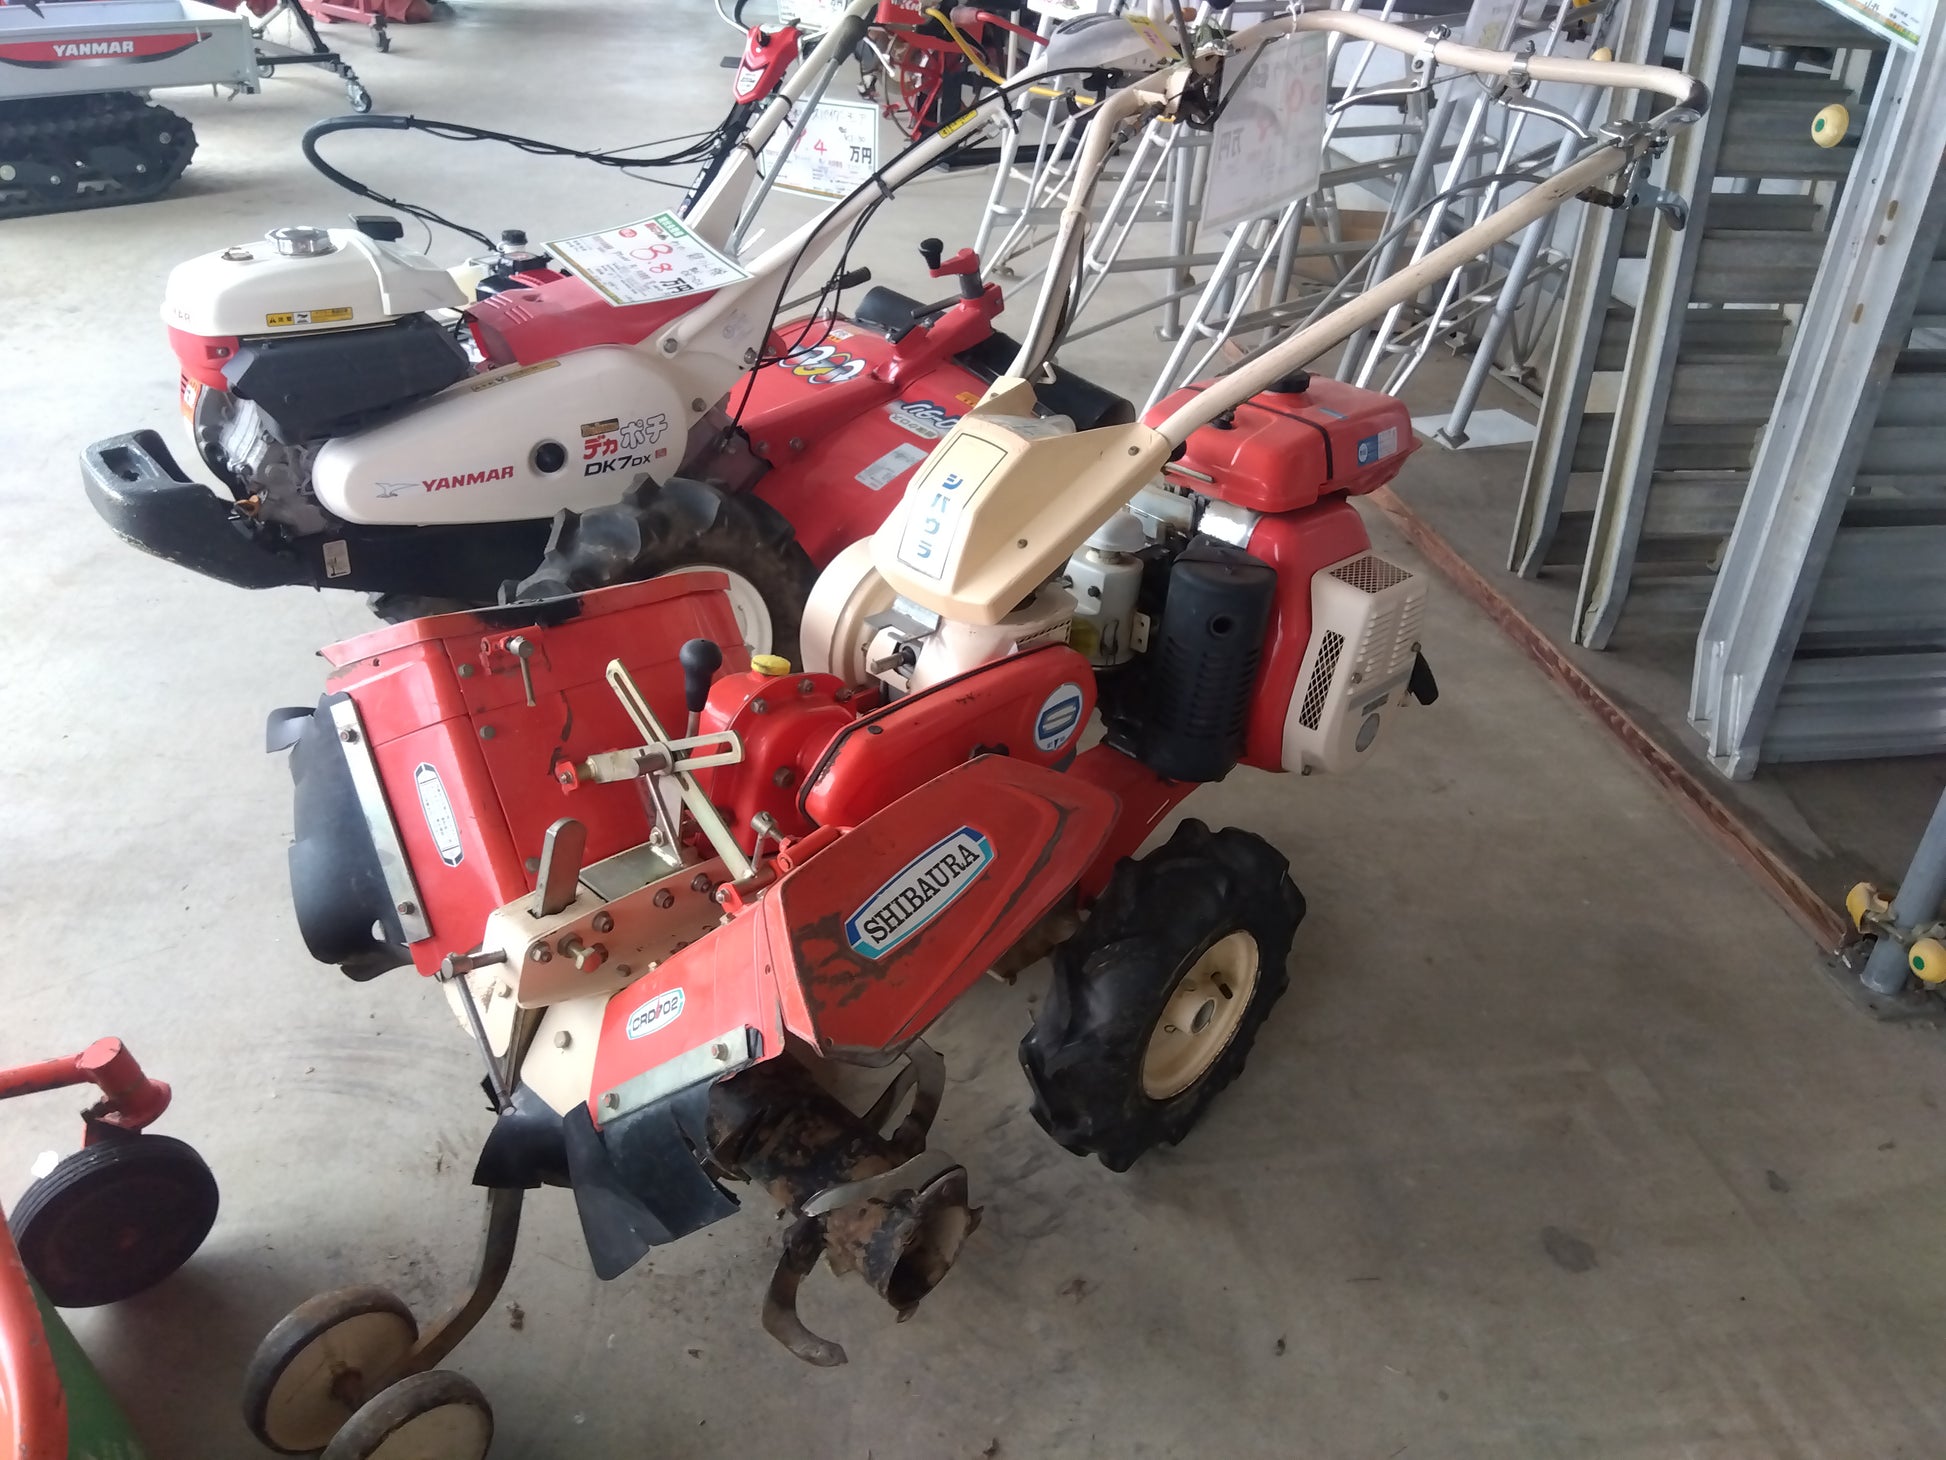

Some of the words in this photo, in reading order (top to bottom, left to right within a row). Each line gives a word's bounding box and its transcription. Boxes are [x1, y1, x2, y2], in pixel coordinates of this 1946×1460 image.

[53, 40, 134, 57] YANMAR
[849, 145, 872, 165] 万円
[659, 277, 694, 294] 万円
[583, 413, 669, 460] デカポチ
[422, 465, 514, 492] YANMAR
[916, 472, 964, 560] シバウラ
[863, 843, 981, 944] SHIBAURA
